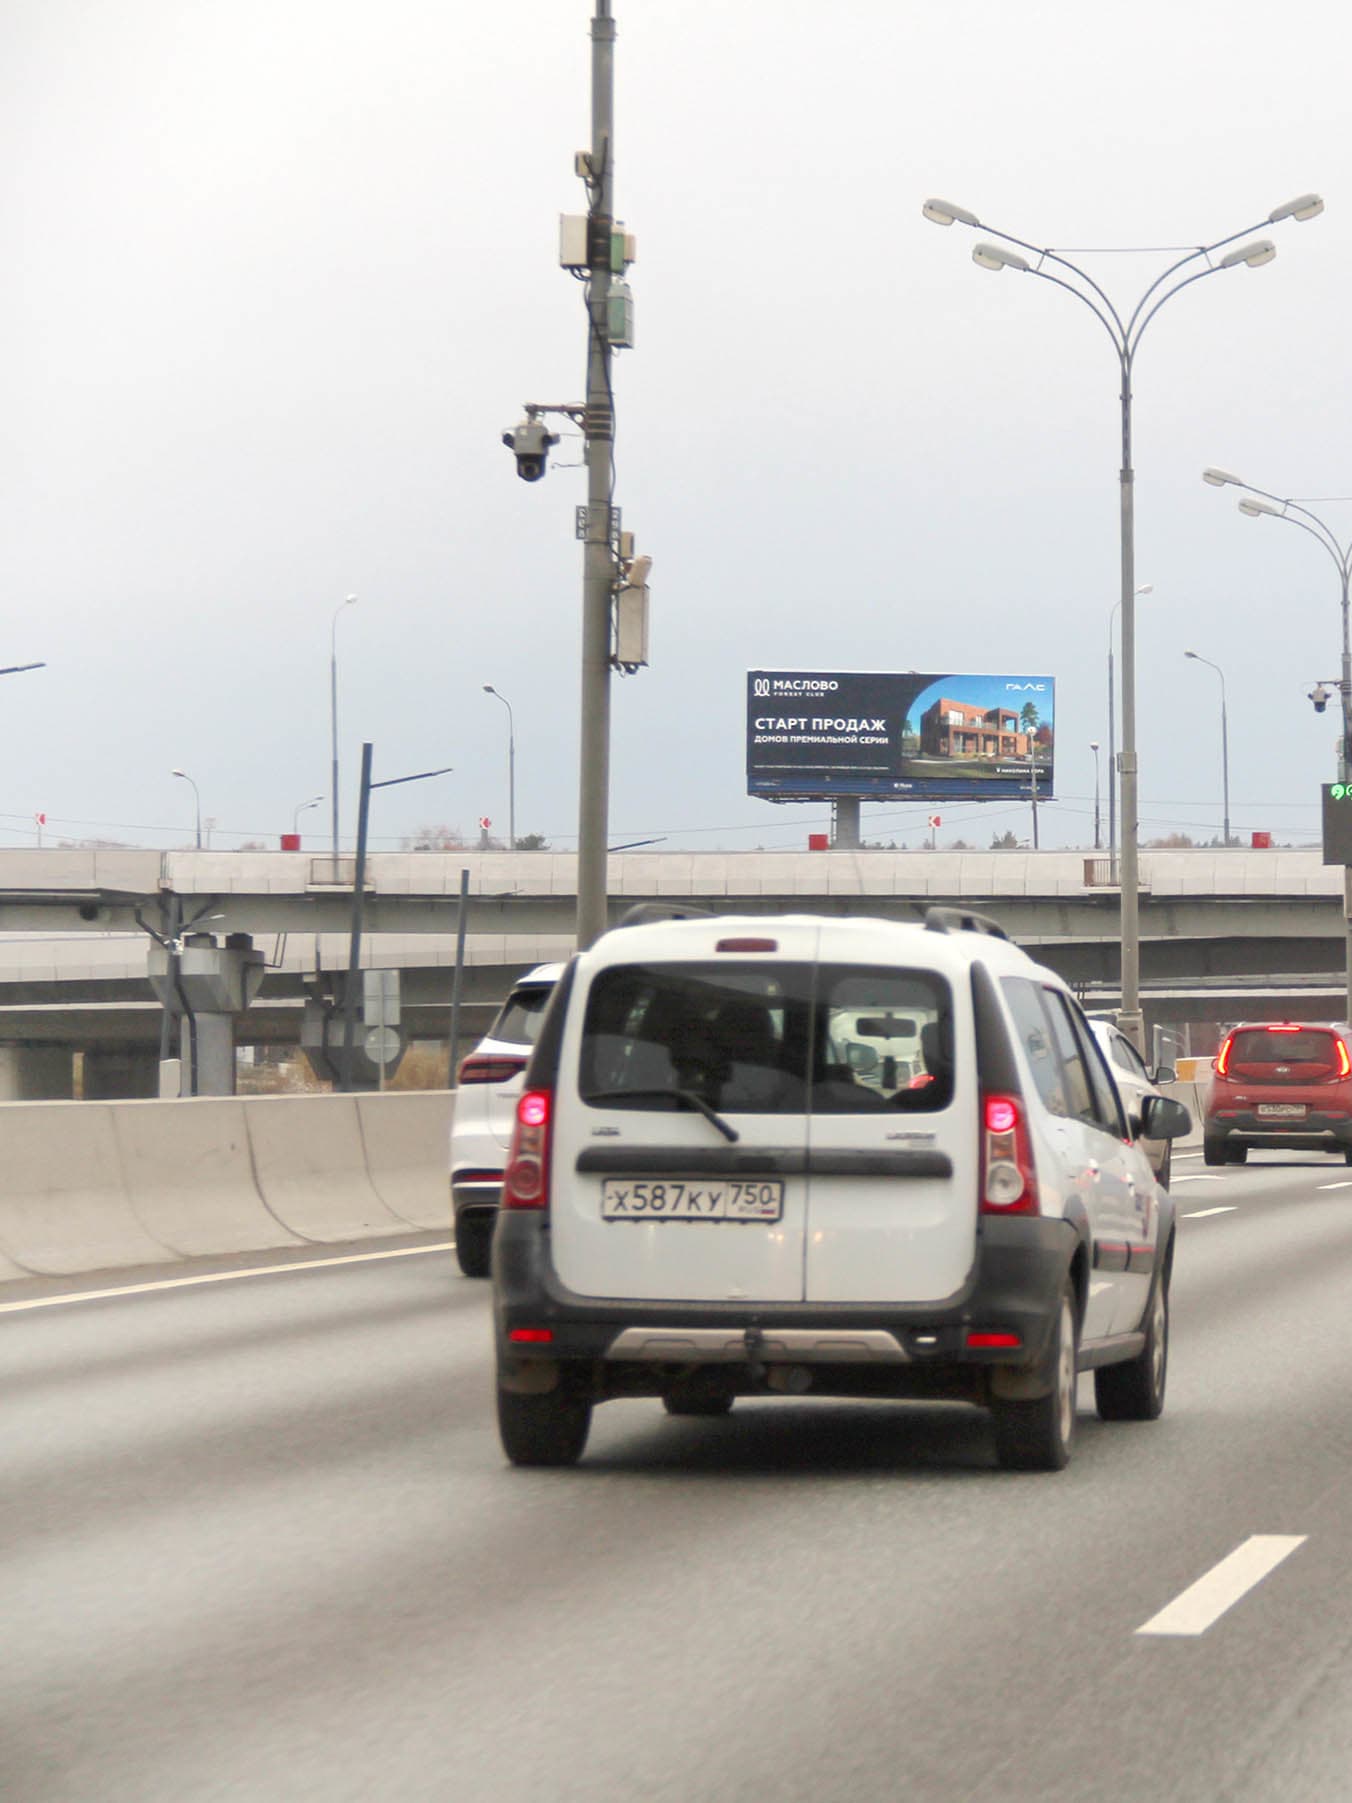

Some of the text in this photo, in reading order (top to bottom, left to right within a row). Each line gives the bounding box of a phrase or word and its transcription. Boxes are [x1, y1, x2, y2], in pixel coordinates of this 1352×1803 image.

[773, 680, 839, 690] МАСЛОВО
[755, 718, 886, 733] СТАРТ ПРОДАЖ
[754, 735, 889, 744] ДОМОВ ПРЕМИАЛЬНОЙ СЕРИИ
[731, 1184, 773, 1205] 750
